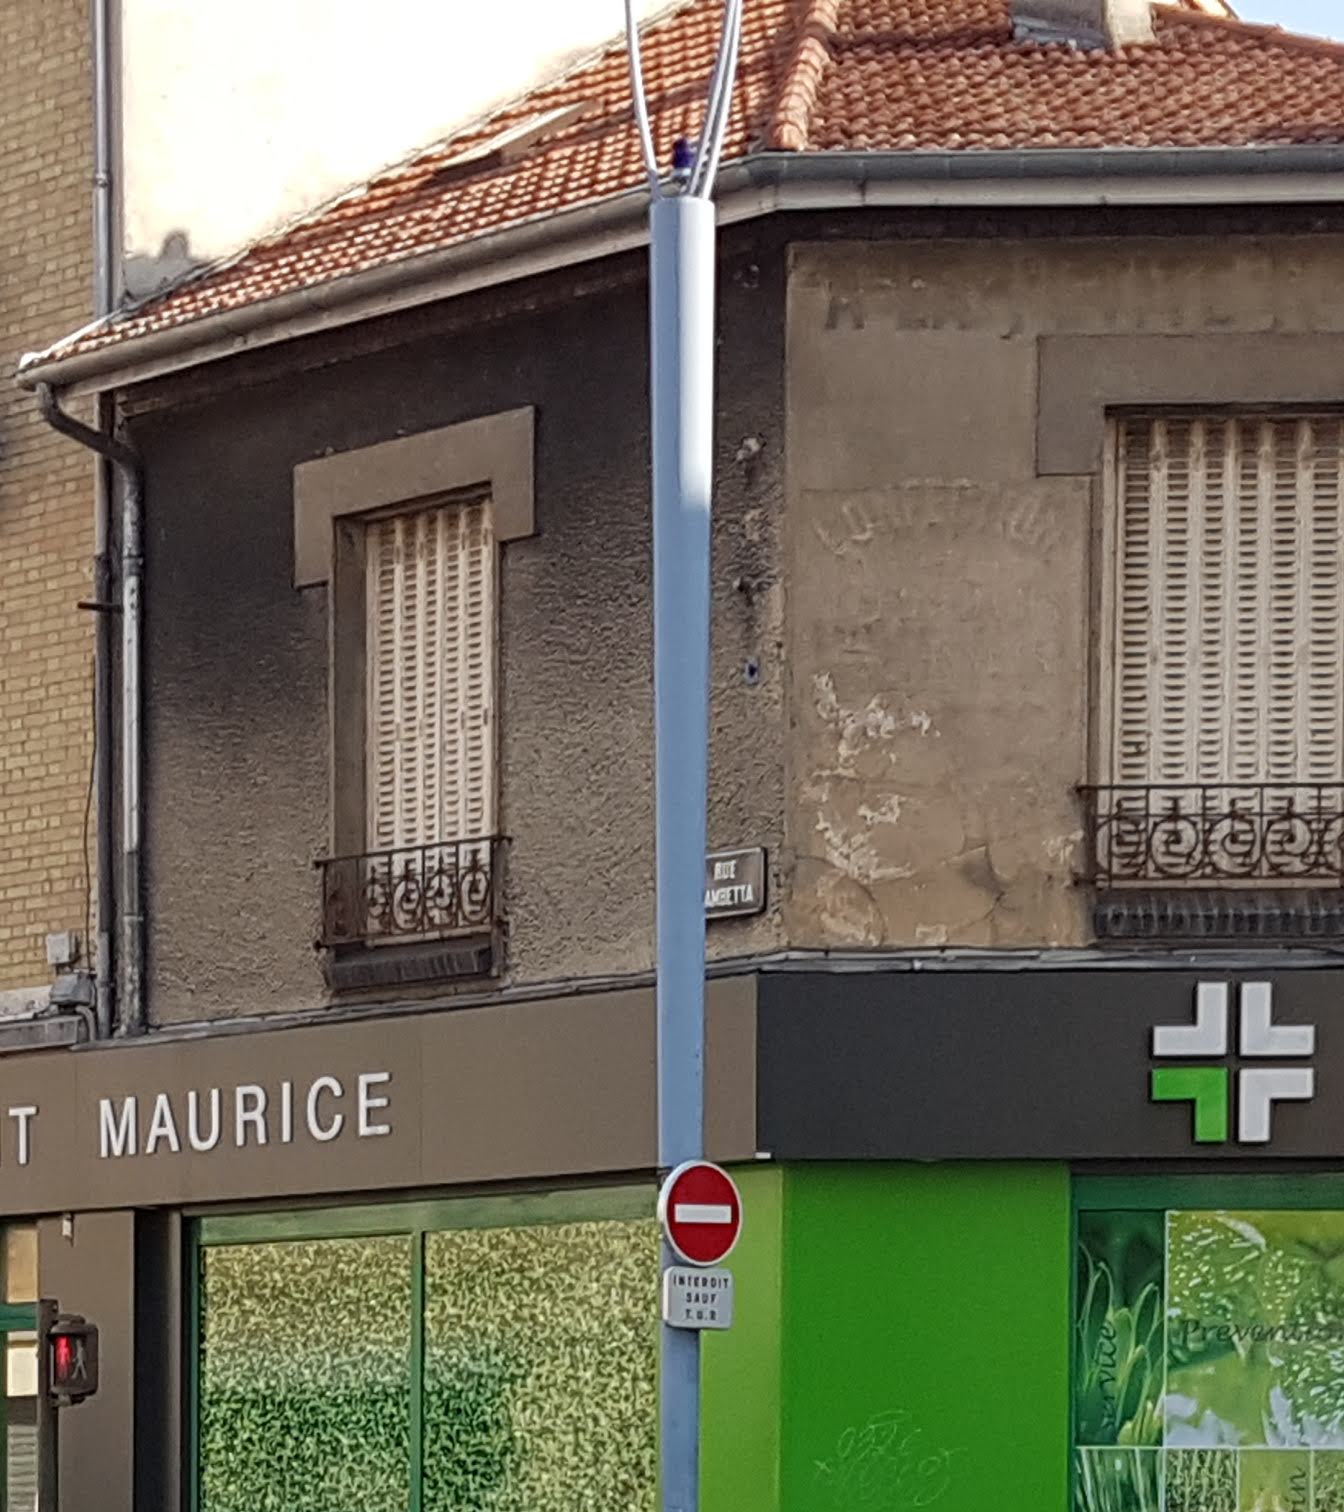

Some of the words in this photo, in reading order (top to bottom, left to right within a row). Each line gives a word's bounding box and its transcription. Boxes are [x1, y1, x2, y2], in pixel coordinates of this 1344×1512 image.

[714, 860, 736, 881] RUE
[99, 1071, 392, 1159] MAURICE
[673, 1274, 729, 1289] INTERDIT
[685, 1292, 717, 1305] SAUF
